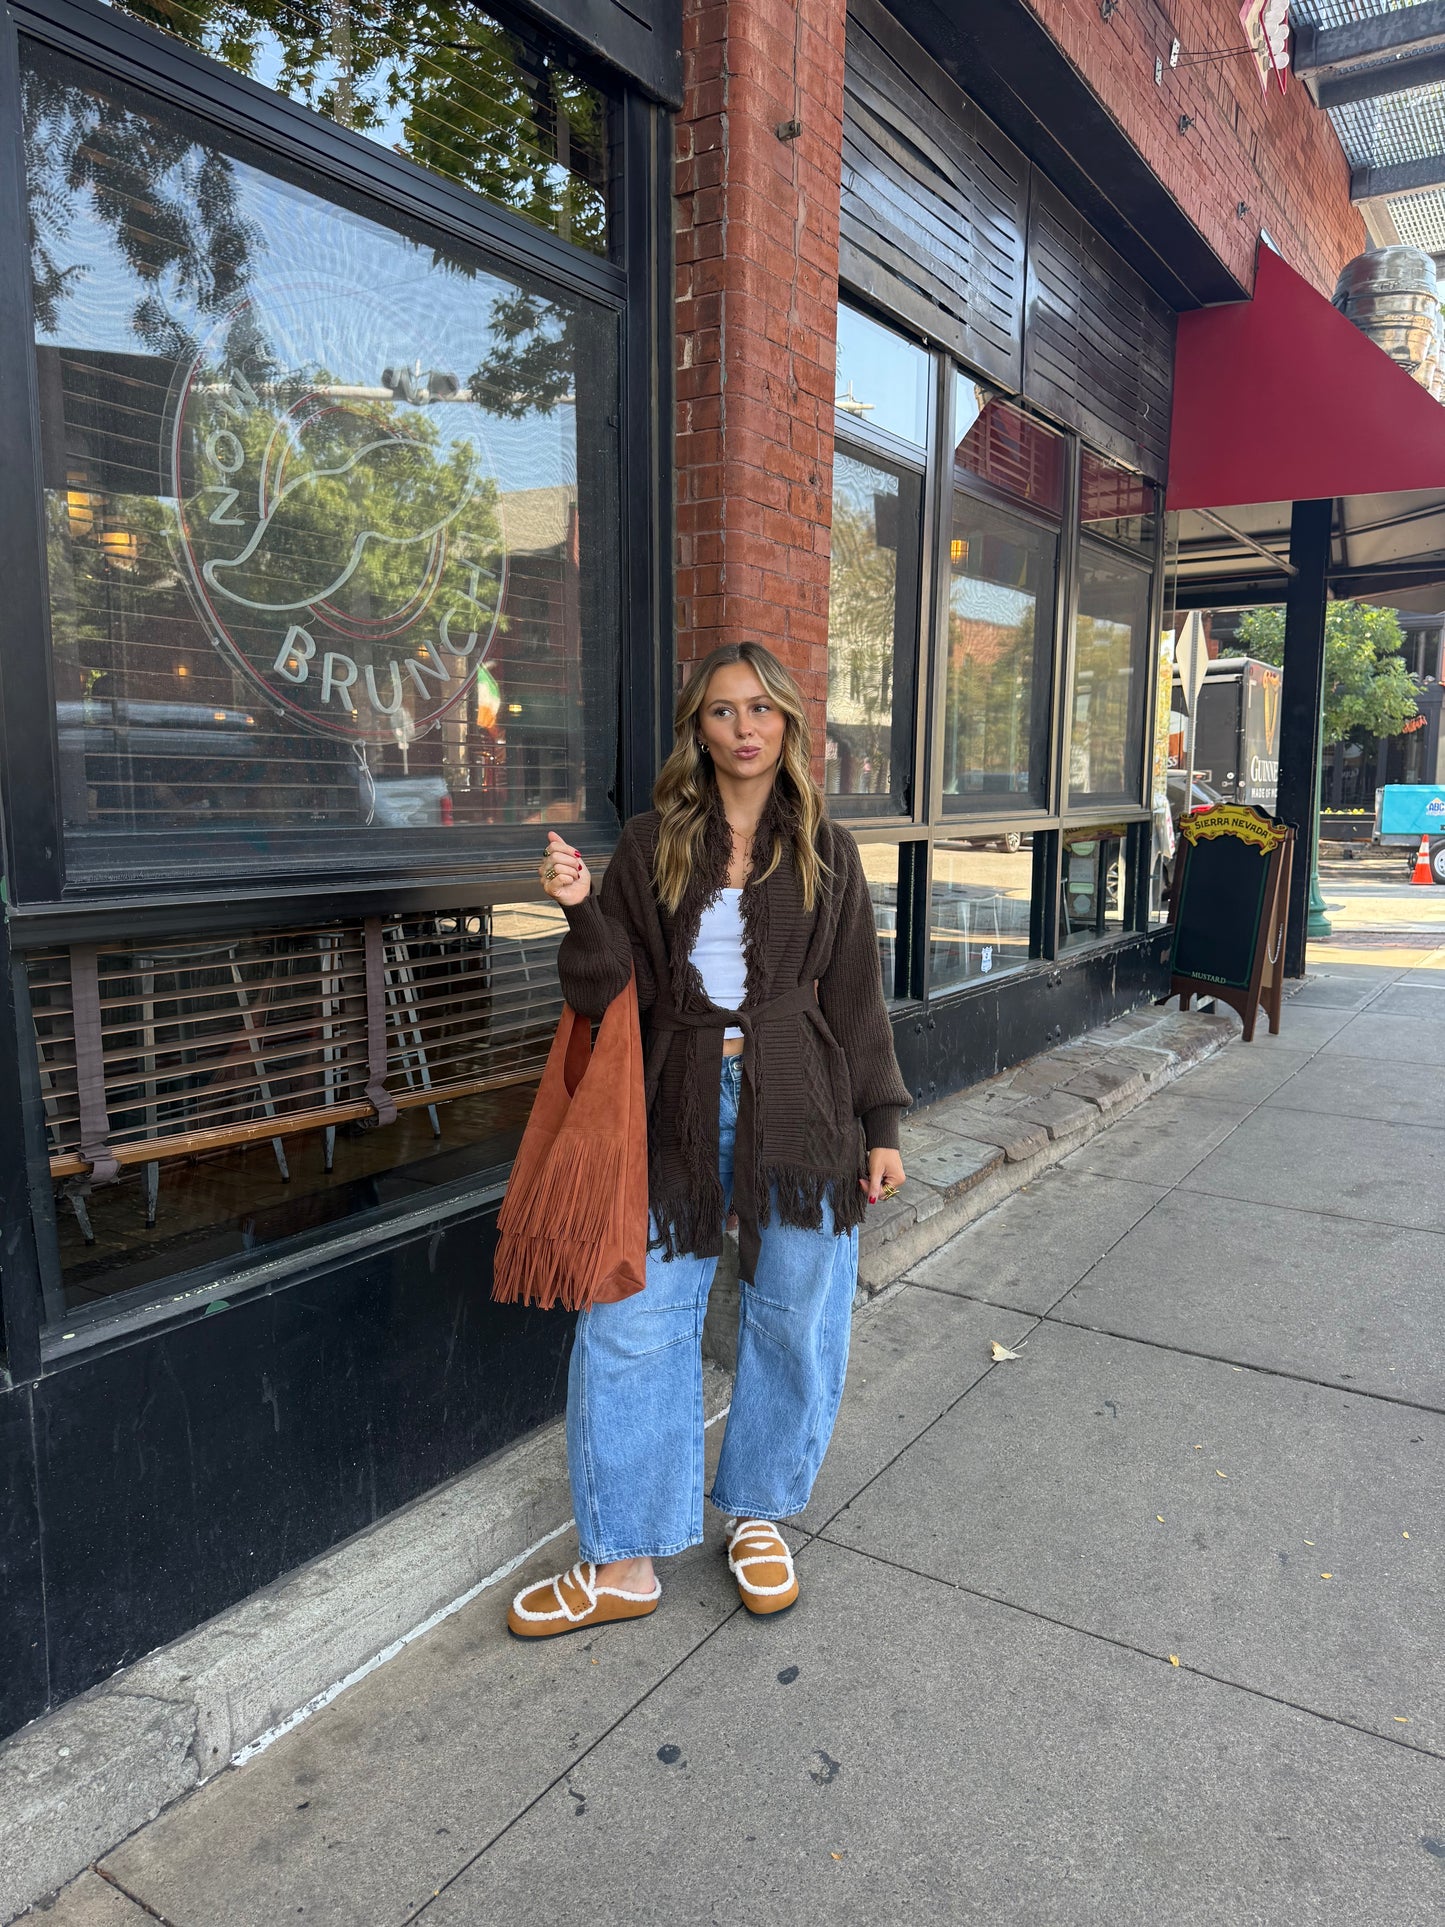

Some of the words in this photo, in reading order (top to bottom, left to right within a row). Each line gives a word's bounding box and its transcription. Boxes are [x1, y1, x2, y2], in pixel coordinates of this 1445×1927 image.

[203, 366, 260, 526] NOW
[273, 556, 497, 714] BRUNCH
[1428, 802, 1445, 811] ABC
[1195, 818, 1229, 830] SIERRA
[1231, 818, 1269, 839] NEVADA
[1191, 971, 1226, 984] MUSTARD
